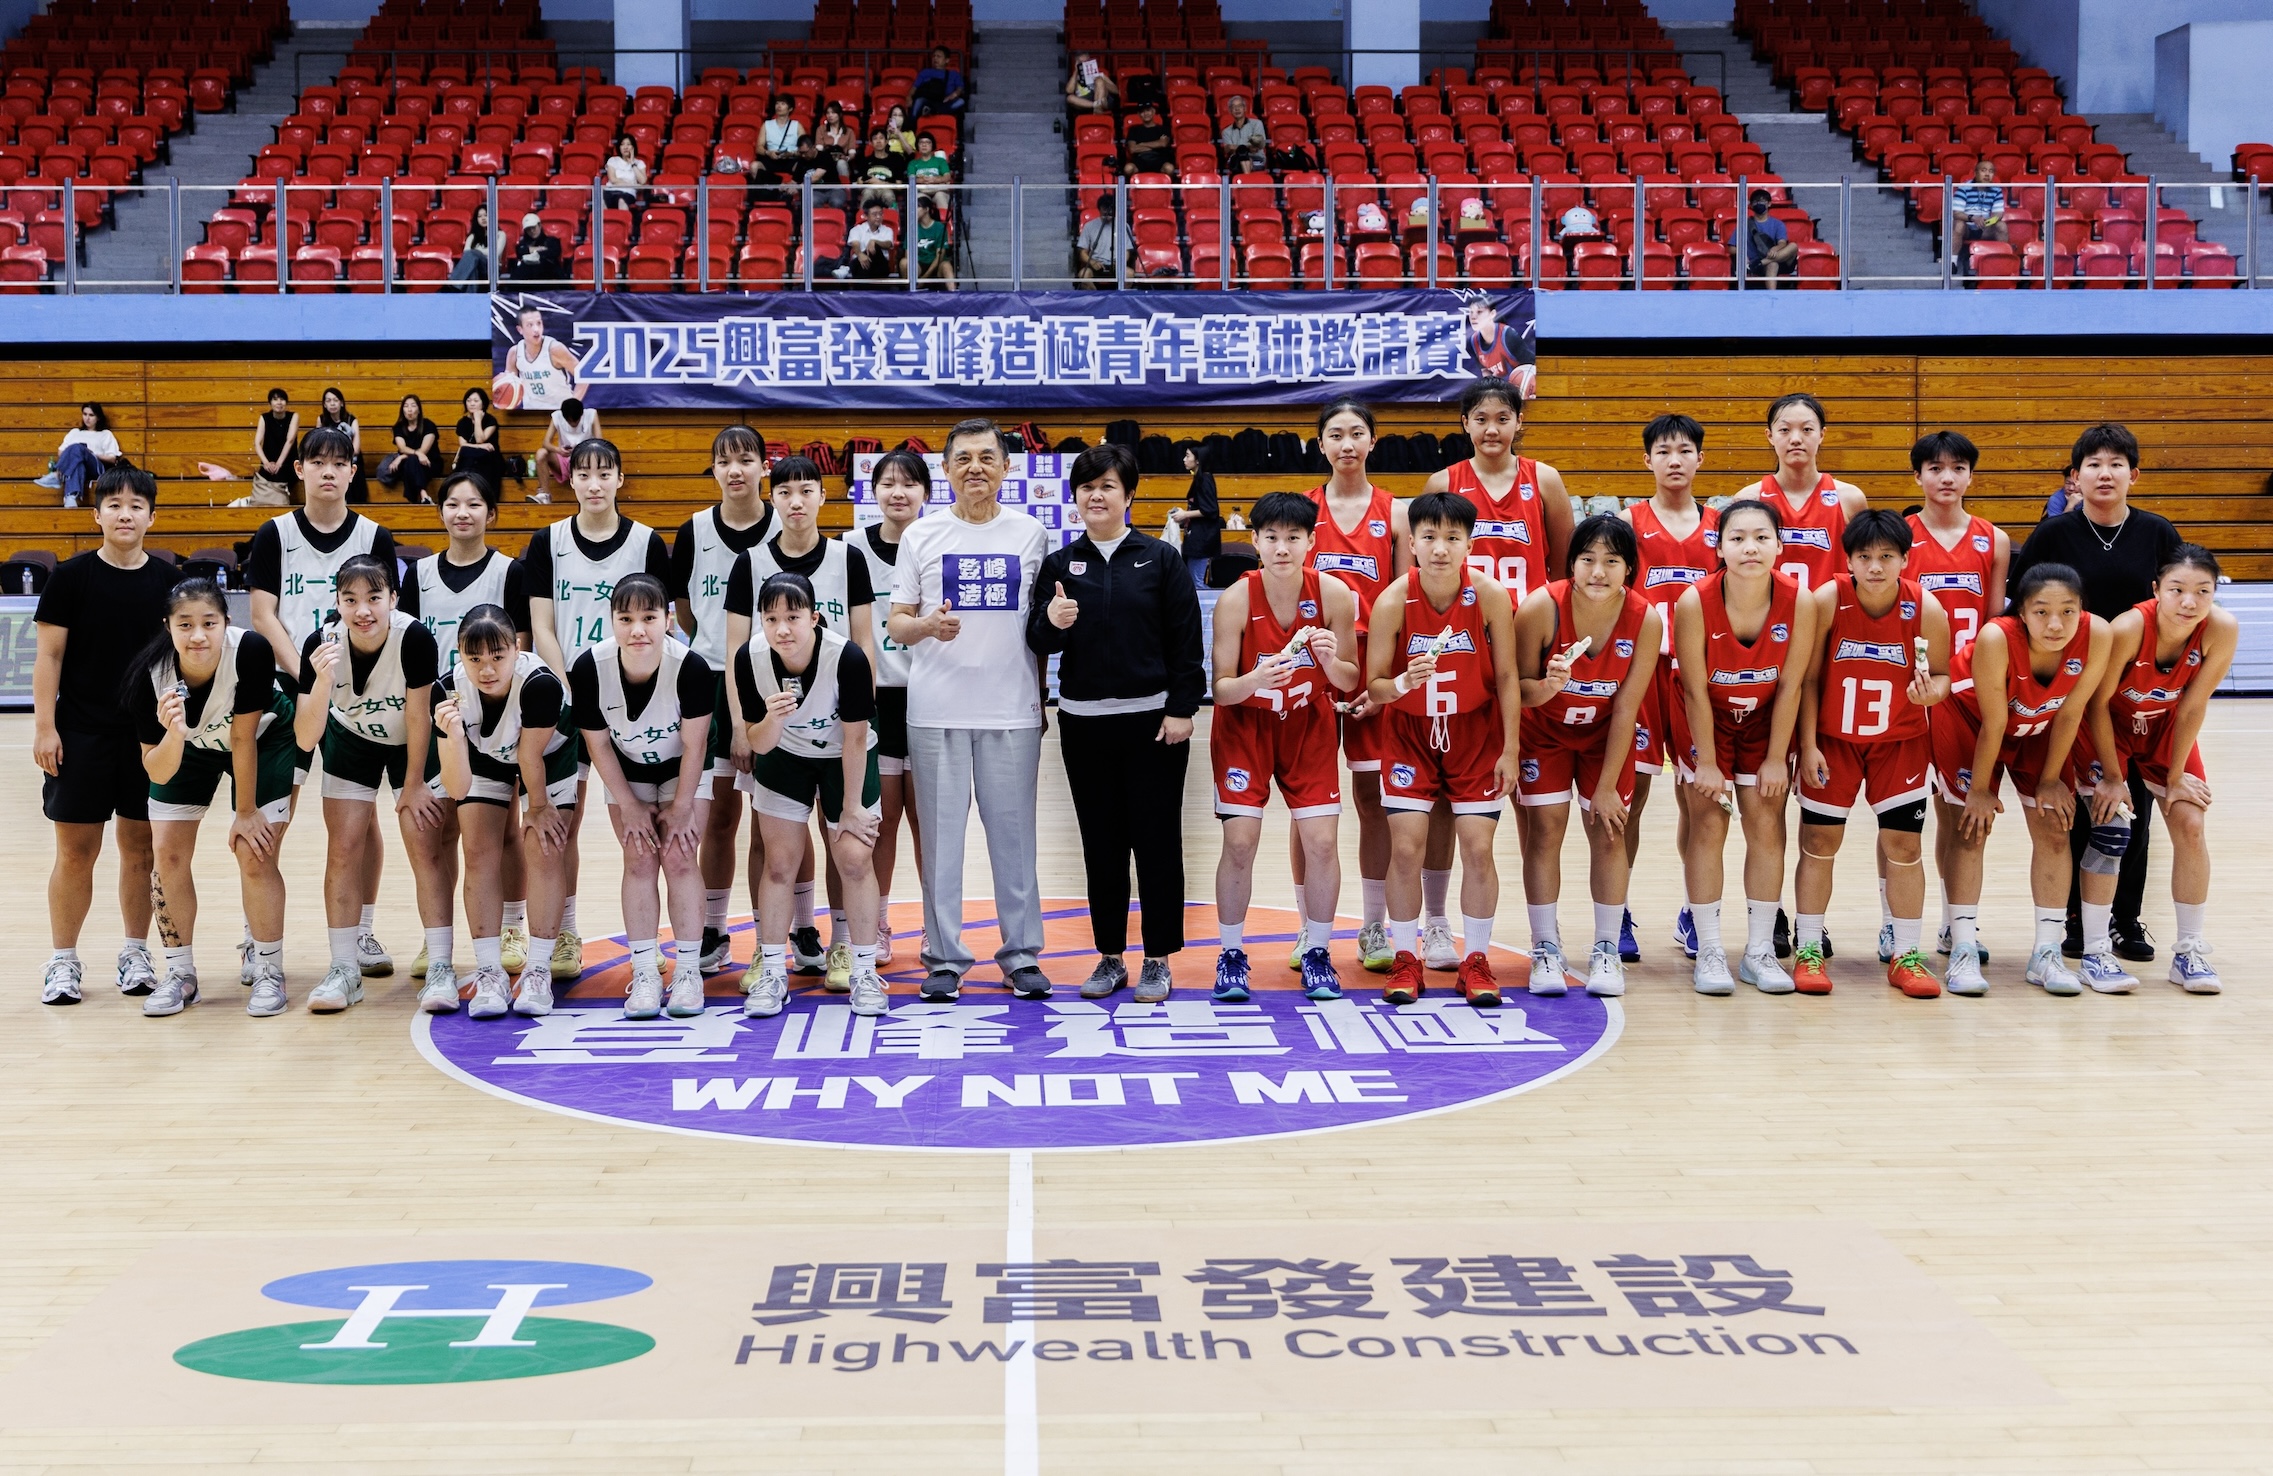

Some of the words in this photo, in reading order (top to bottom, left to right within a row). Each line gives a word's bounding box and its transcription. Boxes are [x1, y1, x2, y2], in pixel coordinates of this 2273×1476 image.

[573, 314, 1476, 386] 2025興富發登峰造極青年籃球邀請賽
[522, 369, 551, 380] 山高中
[530, 382, 546, 395] 28
[958, 558, 1007, 580] 登峰
[958, 583, 1007, 607] 造極
[575, 616, 604, 647] 14
[1426, 671, 1457, 716] 6
[1841, 677, 1893, 736] 13
[354, 721, 388, 738] 18
[490, 997, 1567, 1065] 登峰造極
[672, 1074, 936, 1111] WHY
[961, 1071, 1200, 1107] NOT
[1227, 1069, 1409, 1104] ME
[751, 1254, 1826, 1327] 興富發建設
[734, 1330, 1252, 1372] Highwealth
[1284, 1325, 1860, 1359] Construction
